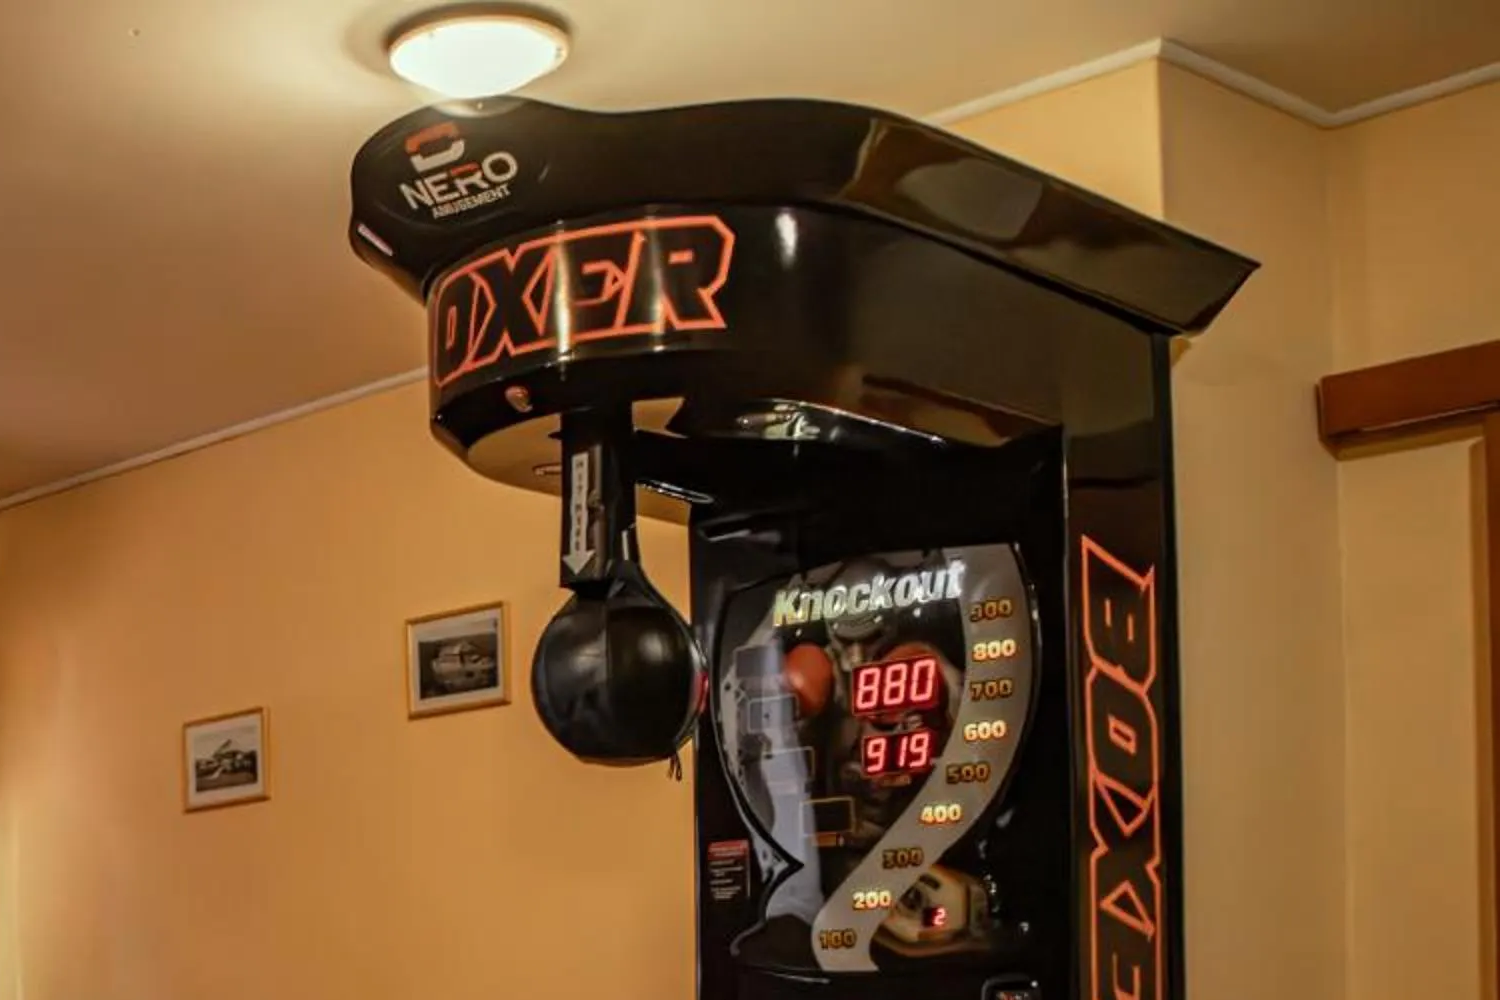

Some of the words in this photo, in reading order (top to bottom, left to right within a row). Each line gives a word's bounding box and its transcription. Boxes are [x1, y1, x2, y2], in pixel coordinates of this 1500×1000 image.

[398, 151, 518, 209] NERO
[431, 183, 512, 219] AMUSEMENT
[773, 559, 966, 627] Knockout
[972, 638, 1017, 661] 800
[855, 658, 936, 710] 880
[969, 679, 1013, 702] 700
[963, 720, 1007, 742] 600
[867, 732, 929, 773] 919
[946, 763, 991, 784] 500
[919, 803, 962, 825] 400
[882, 847, 924, 869] 300
[852, 889, 893, 910] 200
[819, 930, 857, 950] 100
